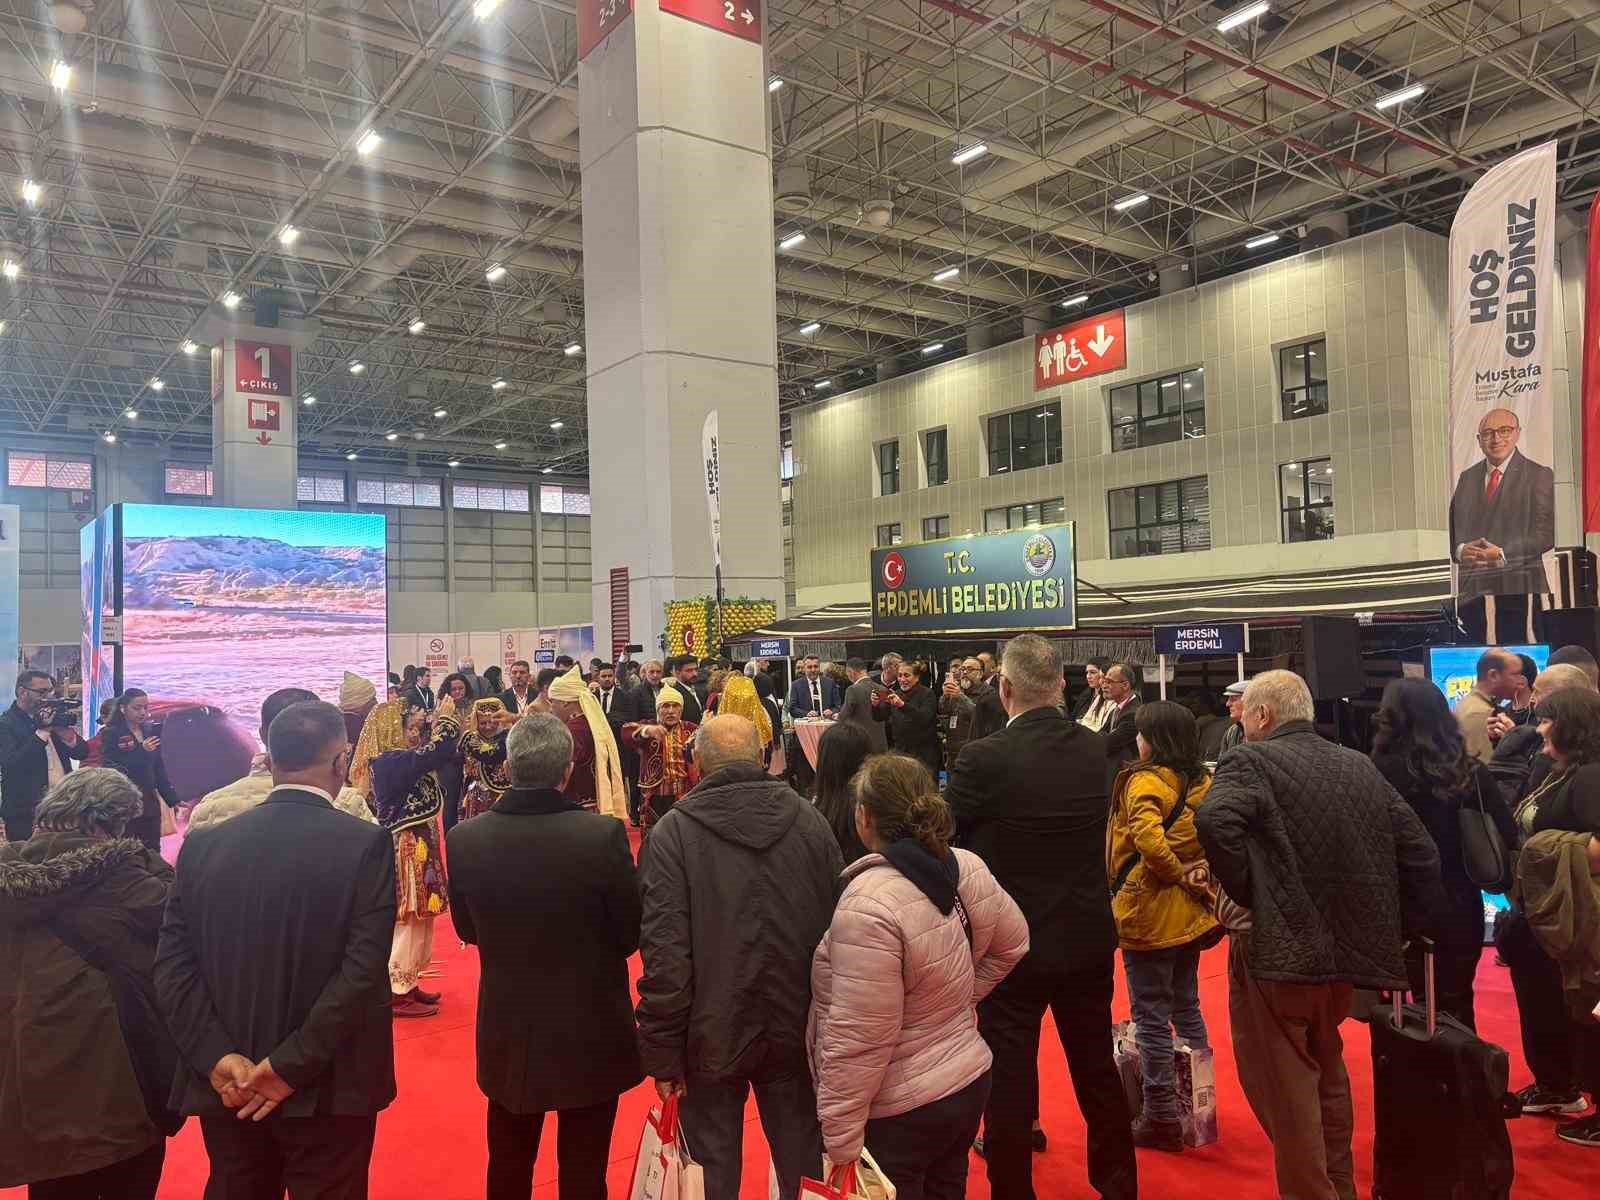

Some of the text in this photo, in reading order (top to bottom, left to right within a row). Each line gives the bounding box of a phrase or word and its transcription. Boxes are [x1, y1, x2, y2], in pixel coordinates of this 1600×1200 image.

[724, 1, 735, 21] 2
[1470, 249, 1504, 324] HOŞ
[1505, 197, 1537, 358] GELDİNİZ
[255, 347, 270, 379] 1
[1475, 363, 1541, 384] Mustafa
[1497, 380, 1539, 399] Kara
[943, 550, 976, 575] T.C.
[877, 578, 1065, 617] ERDEMLİ BELEDİYESİ
[1175, 638, 1223, 650] ERDEMLİ
[1177, 628, 1219, 639] MERSİN
